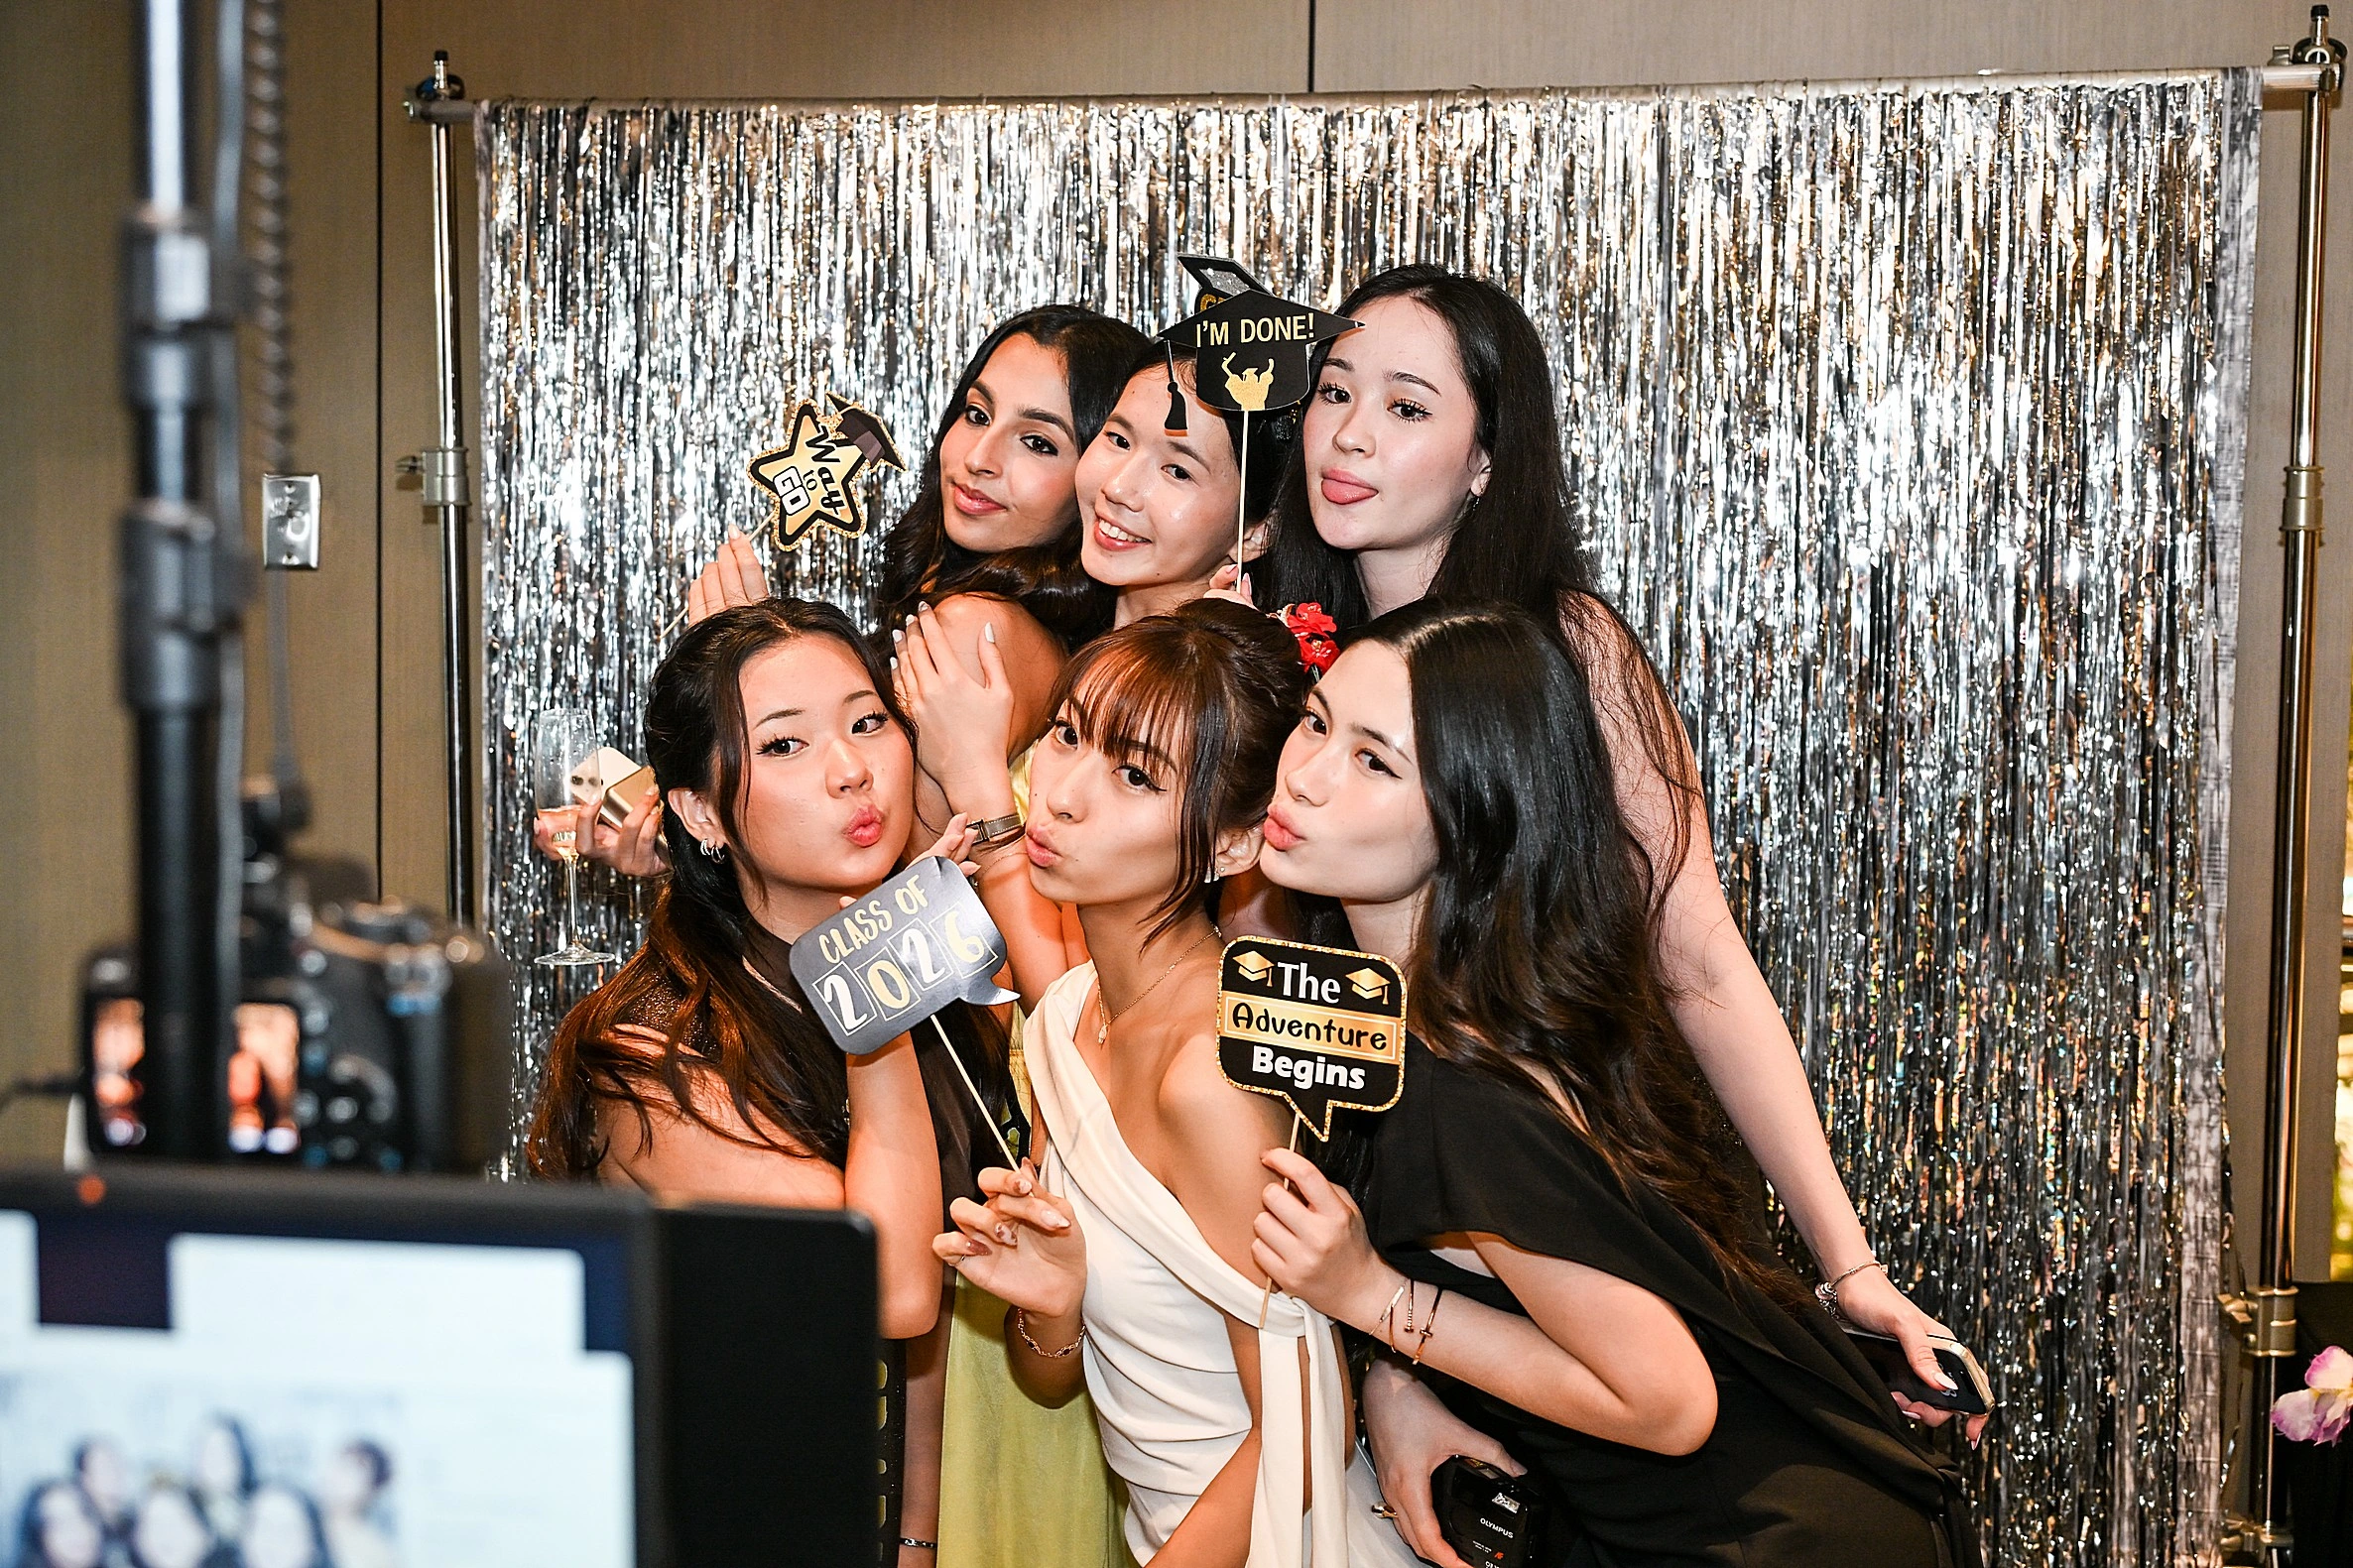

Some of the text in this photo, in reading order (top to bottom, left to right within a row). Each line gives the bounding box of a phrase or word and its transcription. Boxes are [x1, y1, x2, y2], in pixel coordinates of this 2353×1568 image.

[1195, 312, 1314, 347] I'M DONE!
[773, 466, 811, 517] GO
[803, 469, 818, 491] to
[805, 424, 846, 516] Way
[818, 874, 929, 964] CLASS OF
[822, 909, 986, 1030] 2026
[1277, 962, 1341, 1004] The
[1232, 1002, 1387, 1050] Adventure
[1252, 1045, 1366, 1090] Begins
[1479, 1517, 1514, 1538] OLYMPUS
